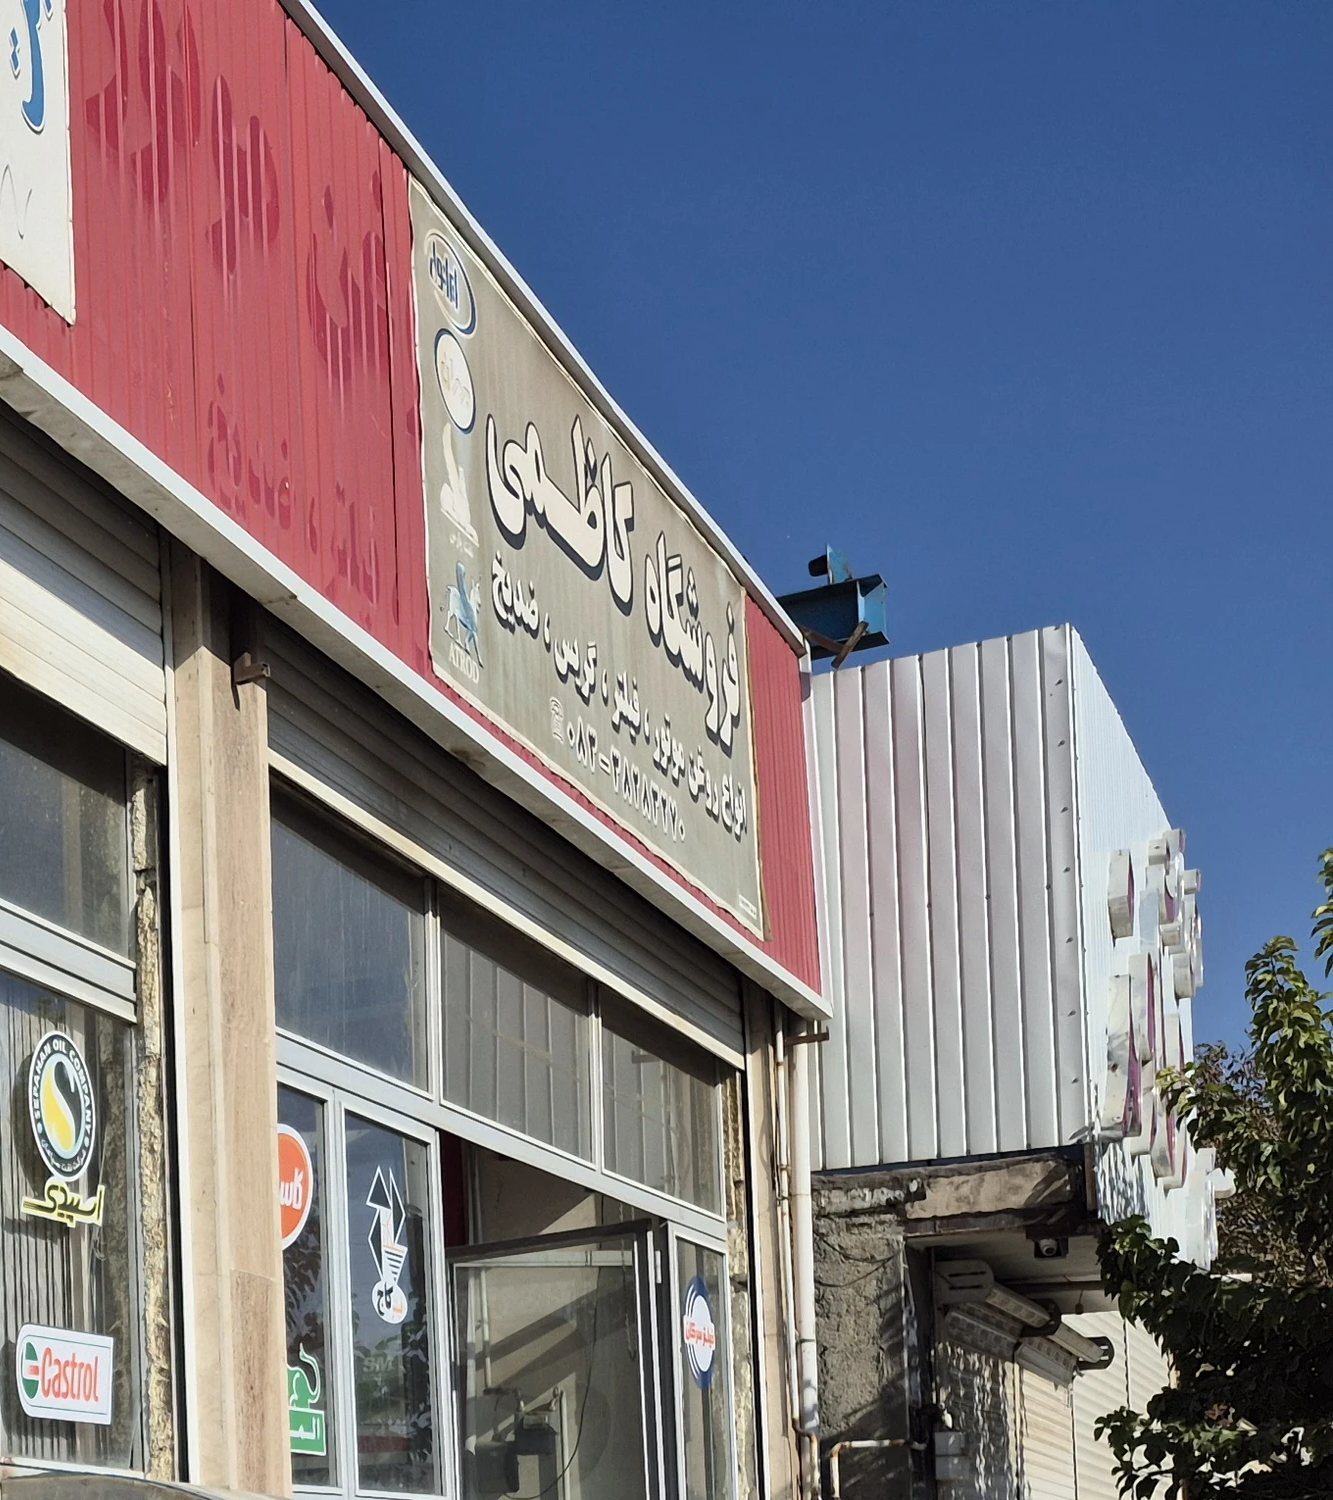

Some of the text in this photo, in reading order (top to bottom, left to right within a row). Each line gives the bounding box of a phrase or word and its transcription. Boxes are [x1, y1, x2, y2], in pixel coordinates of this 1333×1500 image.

[486, 413, 740, 758] فروشگاه کاظمی
[449, 642, 479, 684] ATROD
[554, 639, 597, 707] گریس
[612, 672, 641, 744] فیلتر
[653, 713, 685, 787] موتور
[689, 745, 720, 823] روغن
[721, 774, 747, 842] انواع
[33, 1039, 91, 1133] SEPAHAN OIL COMPANY
[42, 1348, 98, 1403] Castrol
